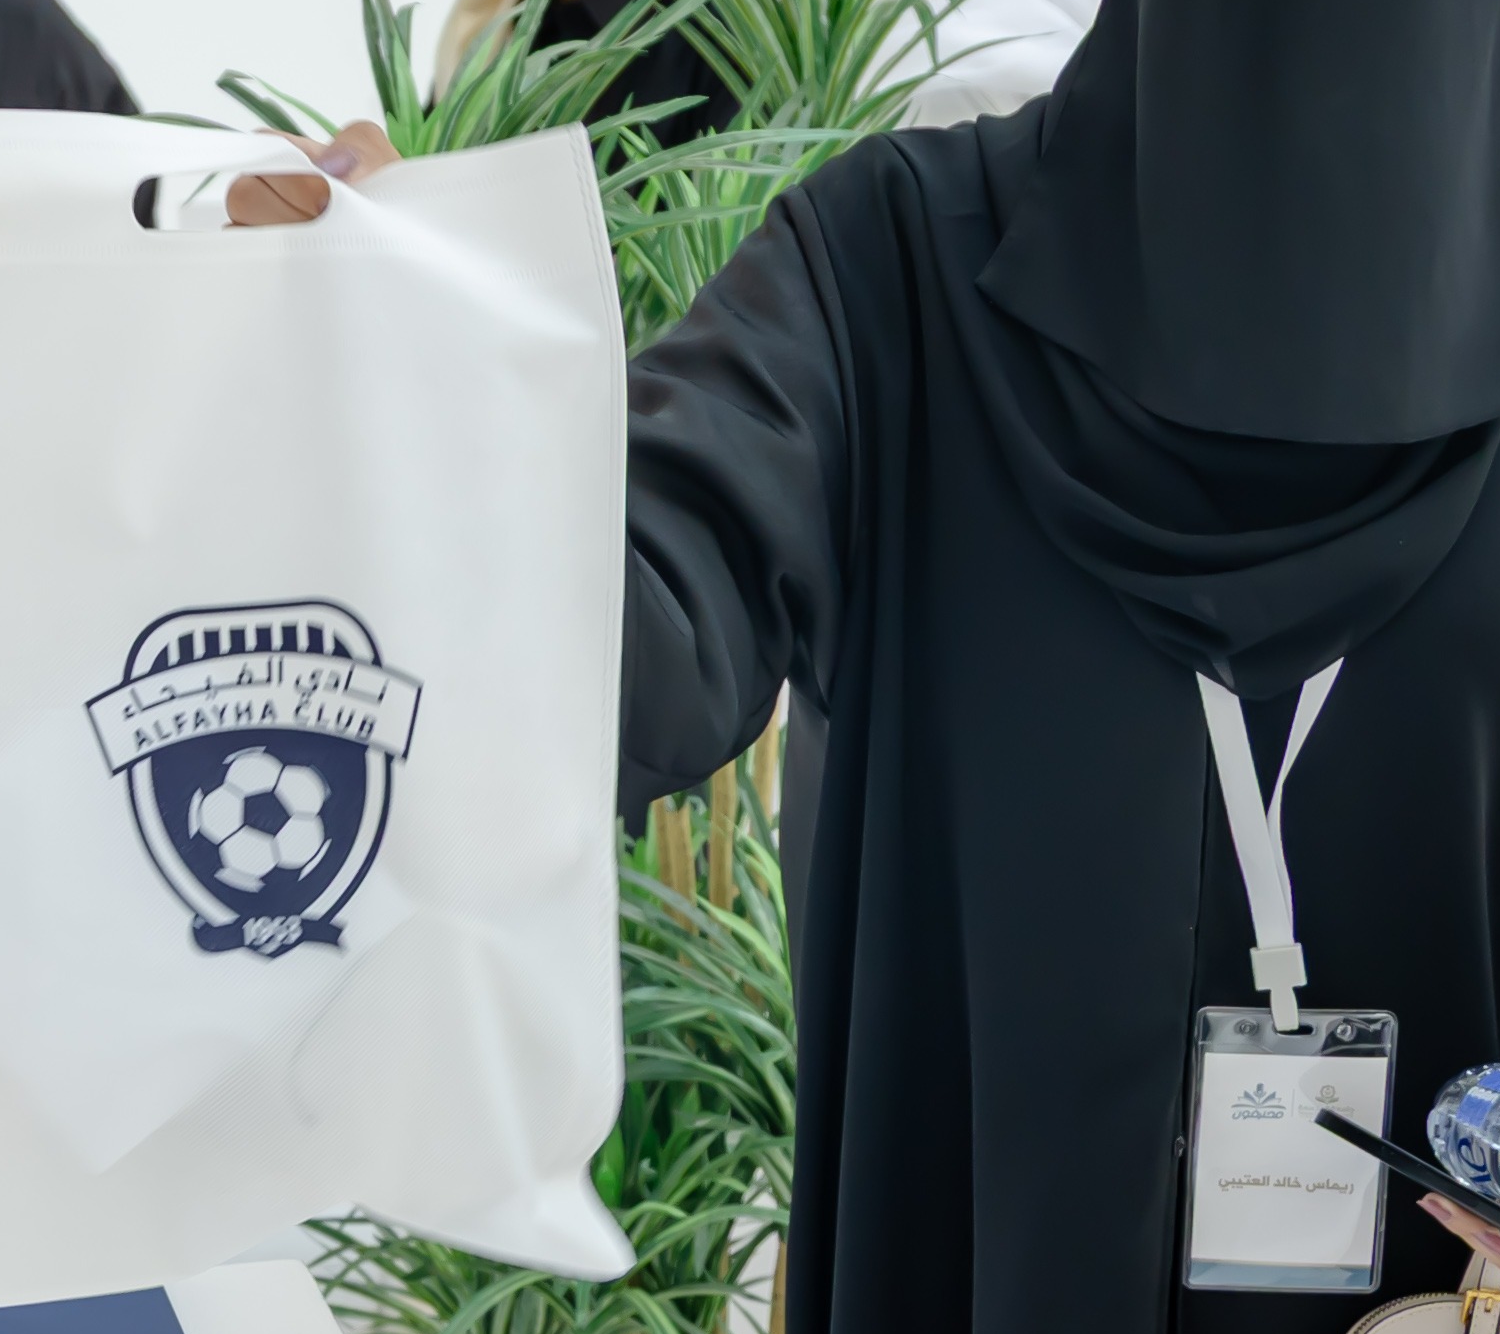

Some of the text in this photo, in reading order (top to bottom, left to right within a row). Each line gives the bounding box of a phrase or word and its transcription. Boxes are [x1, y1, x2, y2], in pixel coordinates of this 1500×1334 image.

[132, 698, 377, 753] ALFAYHA CLUB
[1218, 1174, 1355, 1195] ريماس خالد العتيبي
